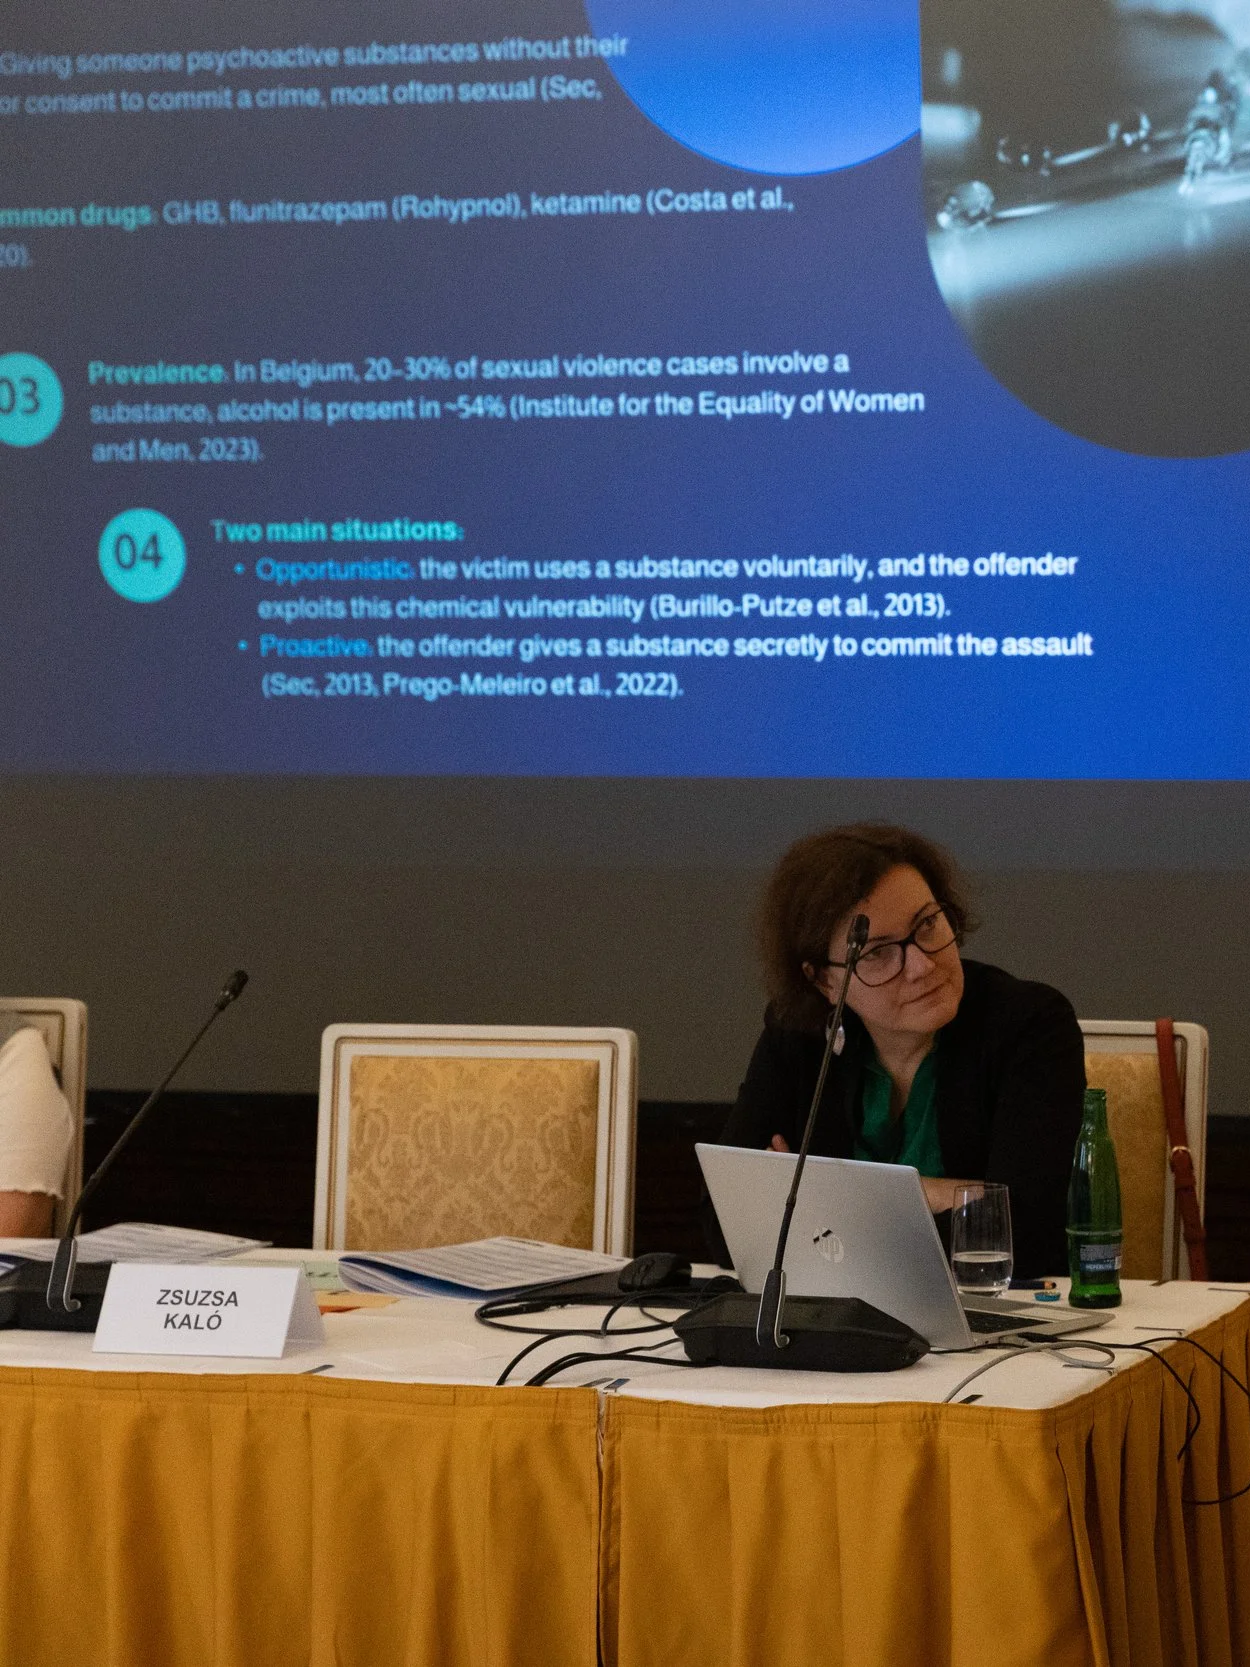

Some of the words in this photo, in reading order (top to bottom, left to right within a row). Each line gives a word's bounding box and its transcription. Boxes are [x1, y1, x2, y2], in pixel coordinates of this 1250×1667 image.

[76, 52, 183, 74] someone
[186, 45, 341, 75] psychoactive
[343, 41, 480, 66] substances
[482, 36, 571, 61] without
[574, 32, 629, 58] their
[24, 90, 117, 114] consent
[120, 90, 145, 112] to
[147, 87, 233, 111] commit
[236, 89, 252, 109] a
[331, 83, 390, 106] most
[392, 80, 455, 104] often
[457, 77, 536, 102] sexual
[229, 200, 388, 225] flunitrazepam
[392, 193, 527, 223] (Rohypnol),
[530, 191, 642, 216] ketamine
[646, 188, 728, 215] (Costa
[731, 188, 756, 211] et
[760, 186, 796, 211] al.,
[234, 360, 257, 383] In
[260, 359, 361, 387] Belgium,
[453, 356, 478, 380] of
[481, 355, 560, 379] sexual
[562, 354, 663, 378] violence
[666, 356, 739, 376] cases
[742, 350, 829, 374] involve
[833, 353, 850, 373] a
[0, 376, 40, 415] 03
[217, 398, 300, 422] alcohol
[303, 399, 324, 421] is
[326, 398, 416, 426] present
[419, 396, 441, 419] in
[509, 394, 615, 420] (Institute
[618, 393, 651, 416] for
[654, 392, 694, 416] the
[698, 391, 796, 420] Equality
[800, 389, 825, 414] of
[828, 389, 925, 413] Women
[92, 440, 136, 462] and
[212, 520, 263, 542] Two
[266, 519, 328, 542] main
[114, 532, 163, 572] 04
[419, 557, 458, 580] the
[461, 557, 531, 580] victim
[534, 560, 592, 579] uses
[595, 560, 612, 579] a
[614, 555, 739, 579] substance
[742, 554, 874, 583] voluntarily,
[877, 553, 925, 577] and
[928, 553, 970, 577] the
[973, 552, 1078, 577] offender
[257, 597, 348, 624] exploits
[350, 596, 394, 619] this
[395, 596, 500, 619] chemical
[504, 595, 646, 623] vulnerability
[650, 593, 813, 620] (Burillo-Putze
[816, 595, 842, 617] et
[845, 593, 880, 619] al.,
[883, 592, 952, 619] 2013).
[377, 635, 416, 657] the
[418, 634, 516, 657] offender
[518, 634, 583, 663] gives
[586, 638, 603, 657] a
[605, 634, 730, 657] substance
[733, 633, 829, 662] secretly
[832, 634, 858, 657] to
[860, 632, 954, 657] commit
[956, 632, 998, 656] the
[1001, 632, 1094, 656] assault
[383, 672, 548, 701] Prego-Meleiro
[550, 674, 575, 696] et
[578, 673, 613, 698] al.,
[615, 672, 687, 698] 2022).
[156, 1288, 239, 1307] ZSUZSA
[163, 1309, 222, 1330] KALÓ
